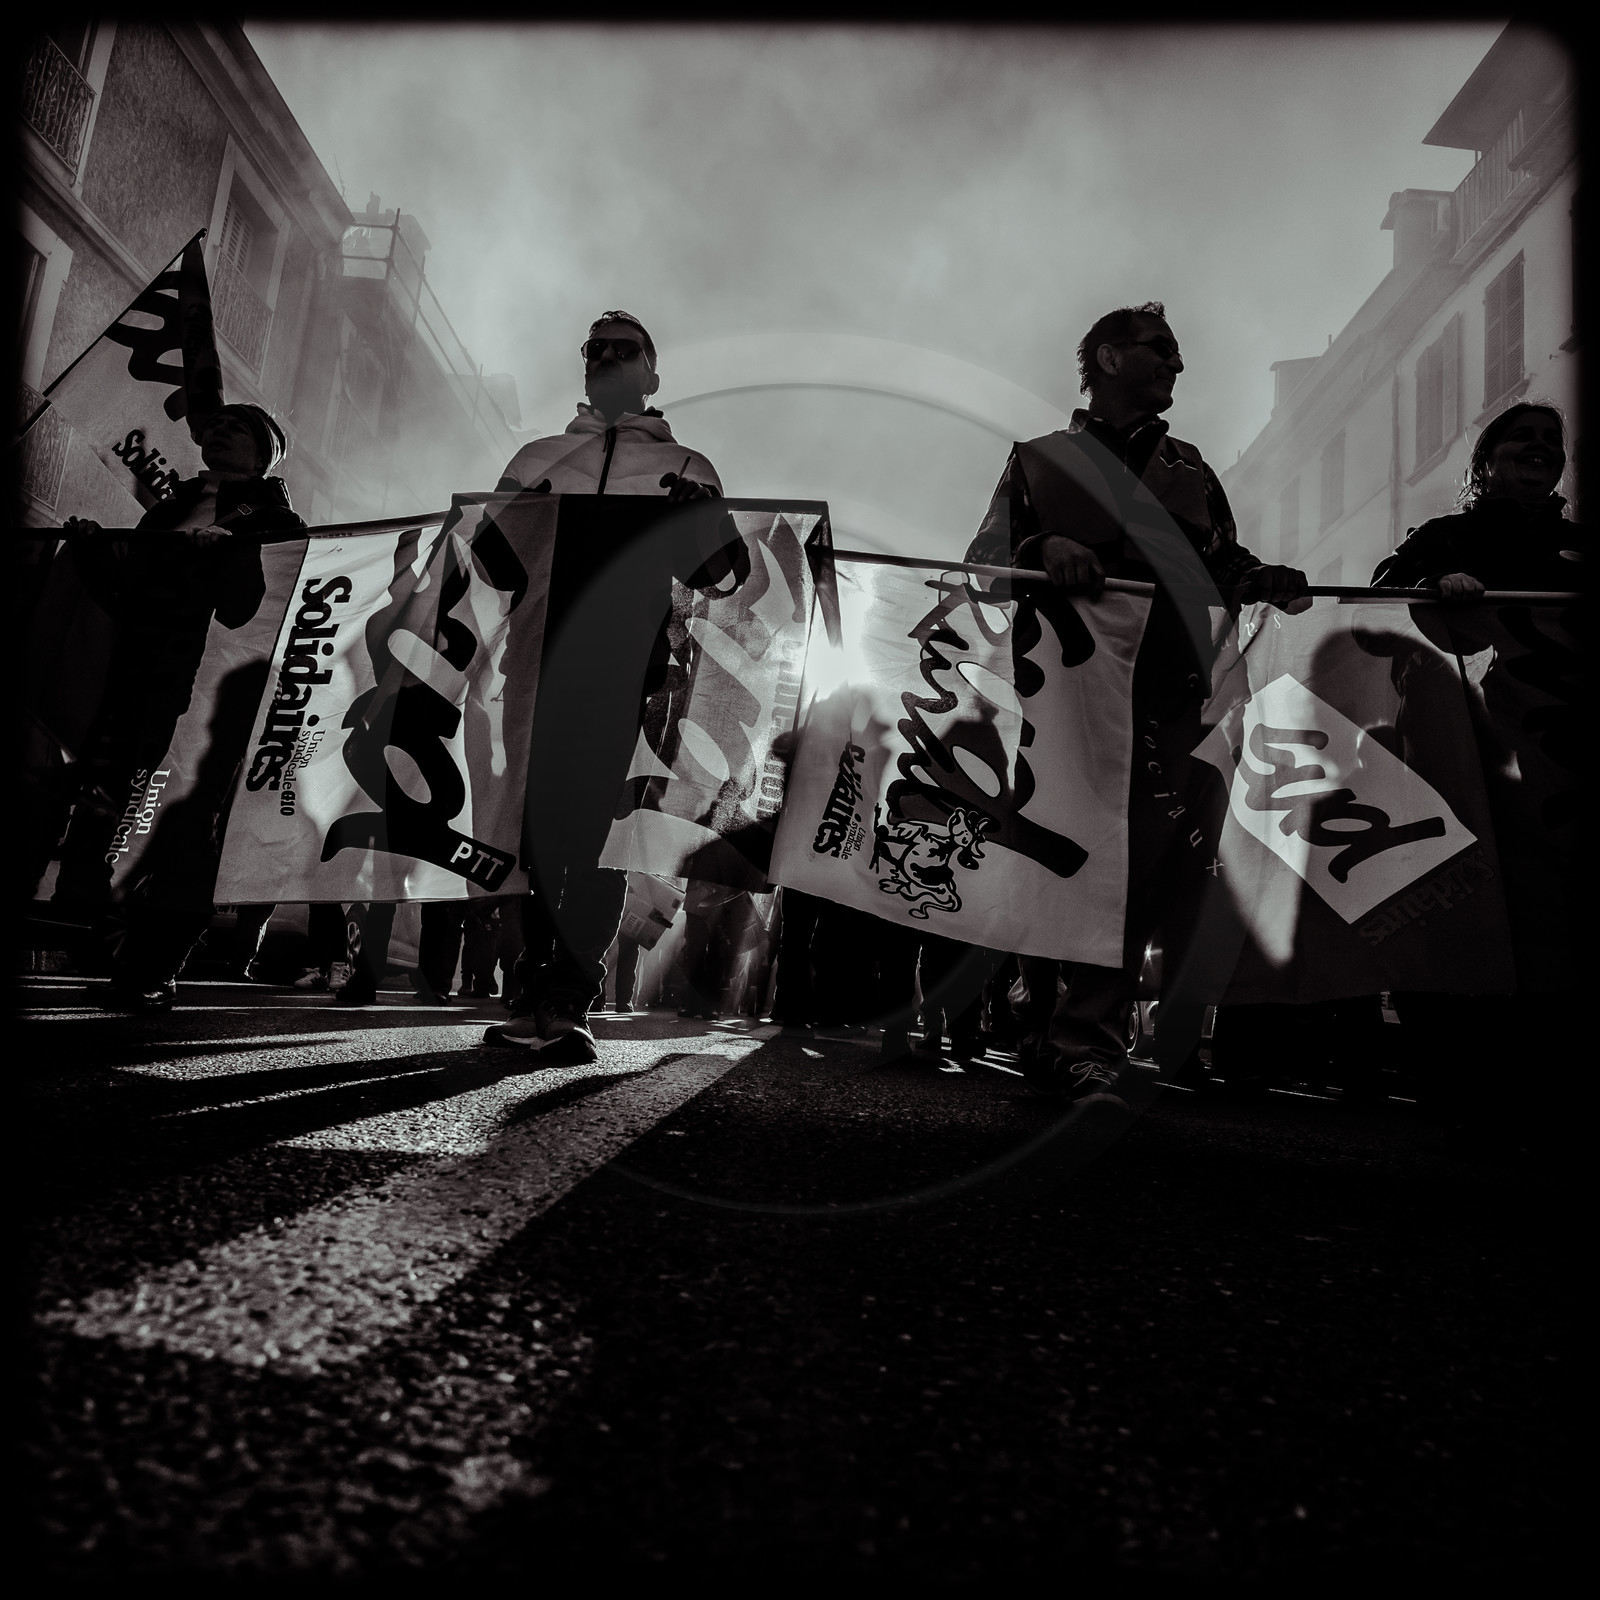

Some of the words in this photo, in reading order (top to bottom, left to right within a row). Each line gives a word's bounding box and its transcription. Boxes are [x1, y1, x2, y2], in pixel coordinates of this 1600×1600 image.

[246, 575, 353, 792] Solidaires
[281, 730, 312, 792] syndicale
[298, 730, 326, 770] Union
[104, 768, 148, 865] syndicale
[134, 768, 172, 835] Union
[449, 840, 506, 882] PTT
[841, 821, 858, 862] syndicale
[851, 827, 867, 853] Union
